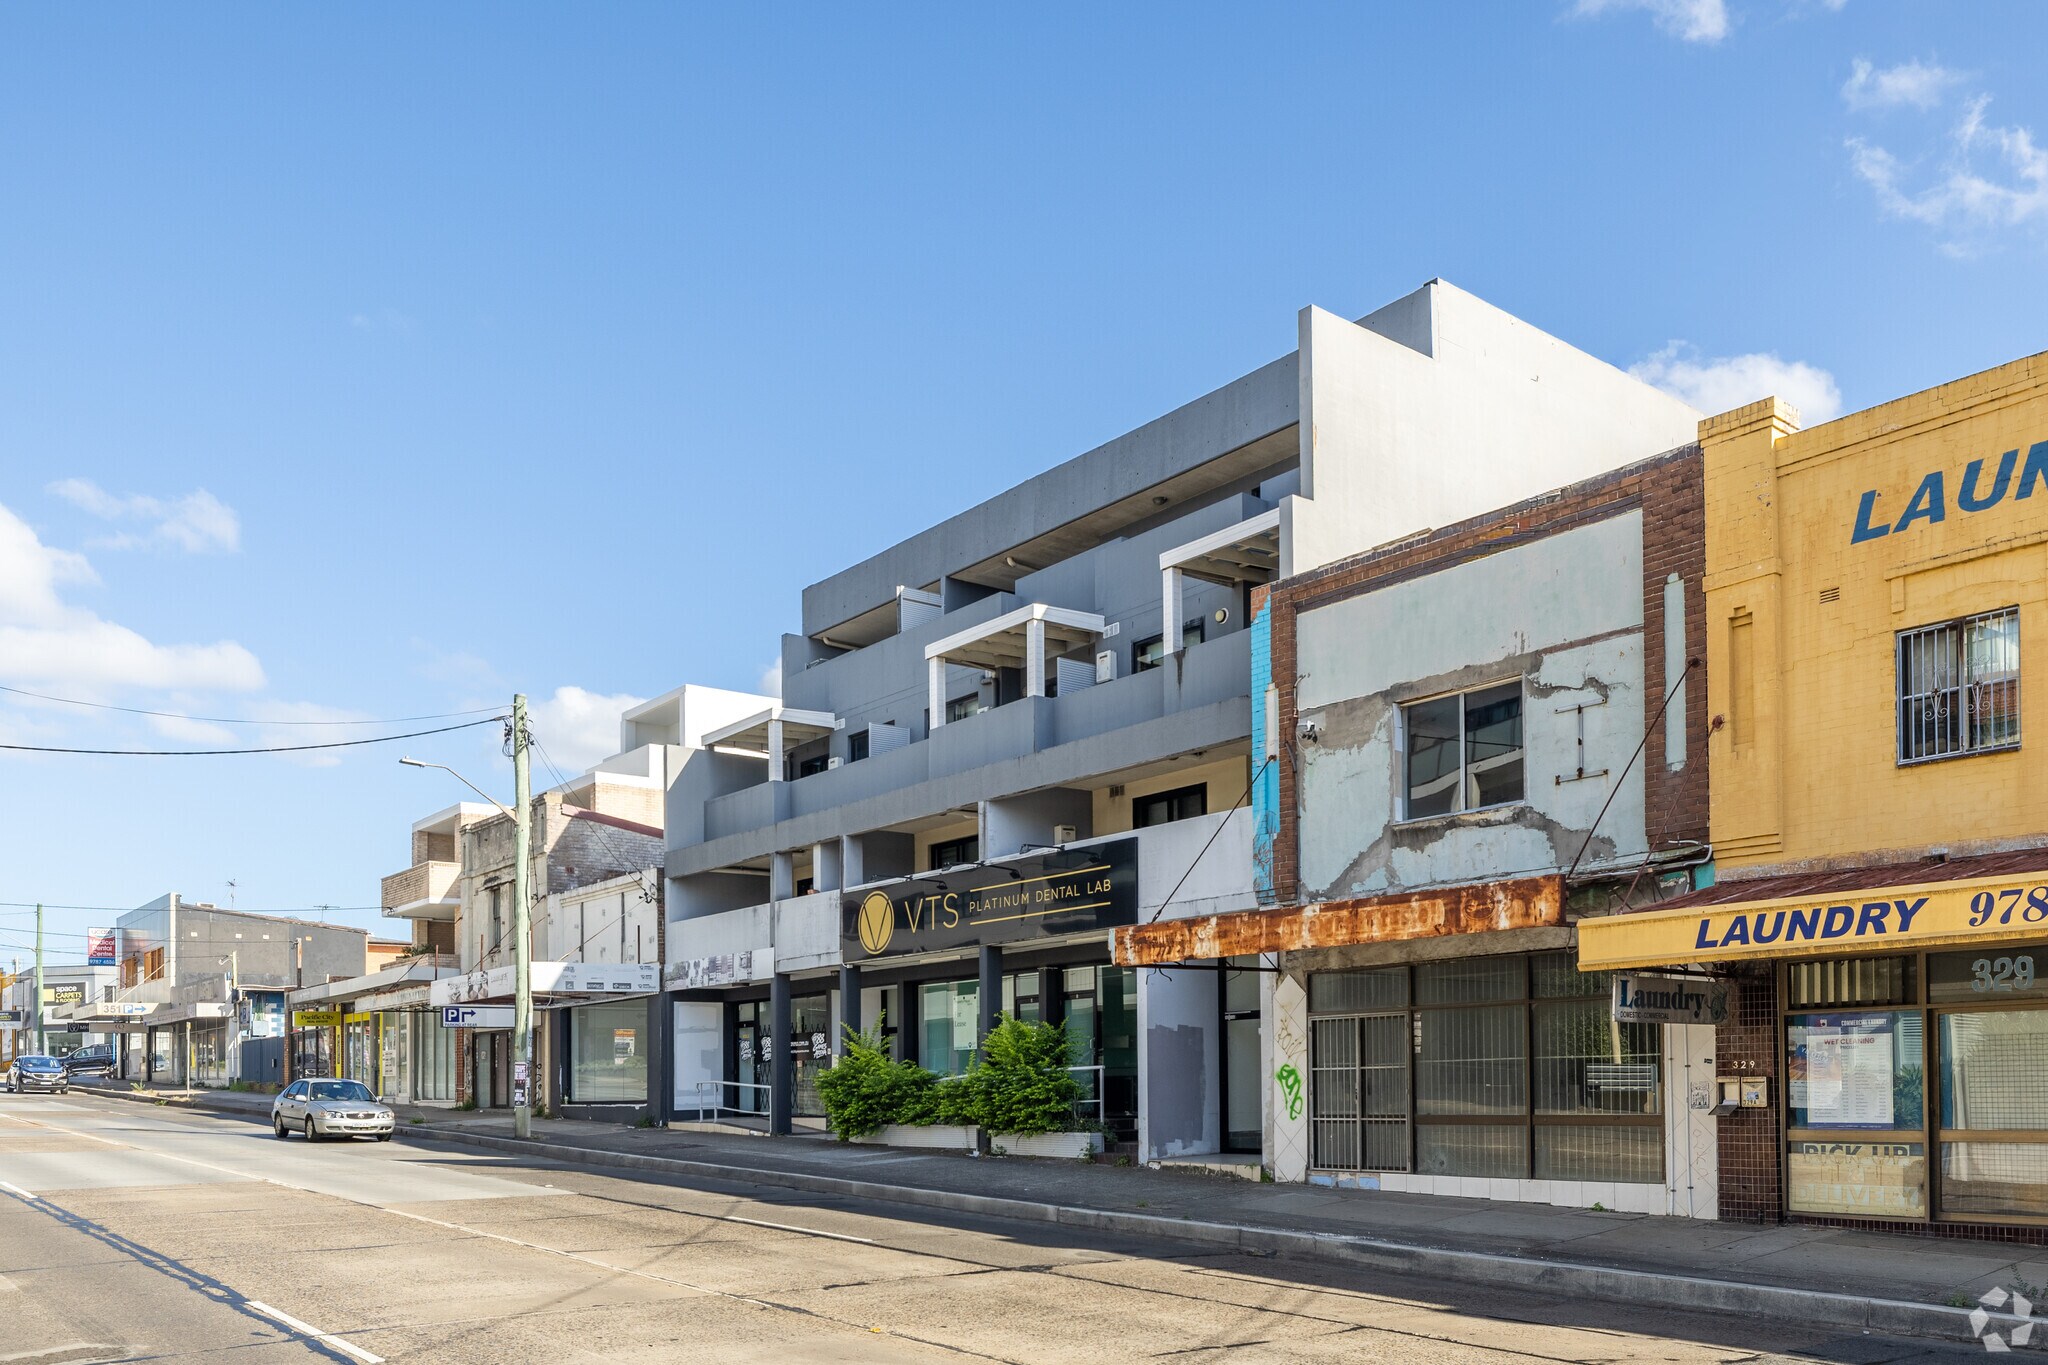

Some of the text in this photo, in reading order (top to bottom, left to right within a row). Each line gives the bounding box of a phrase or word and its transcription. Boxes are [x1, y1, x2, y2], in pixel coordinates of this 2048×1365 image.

[904, 879, 1112, 933] VTS PLATINUM DENTAL LAB
[1695, 886, 2048, 949] LAUNDRY 978
[1970, 956, 2034, 992] 329
[103, 1004, 120, 1013] 351
[448, 1009, 458, 1021] P
[1619, 979, 1706, 1019] Laundry
[1733, 1061, 1755, 1069] 329
